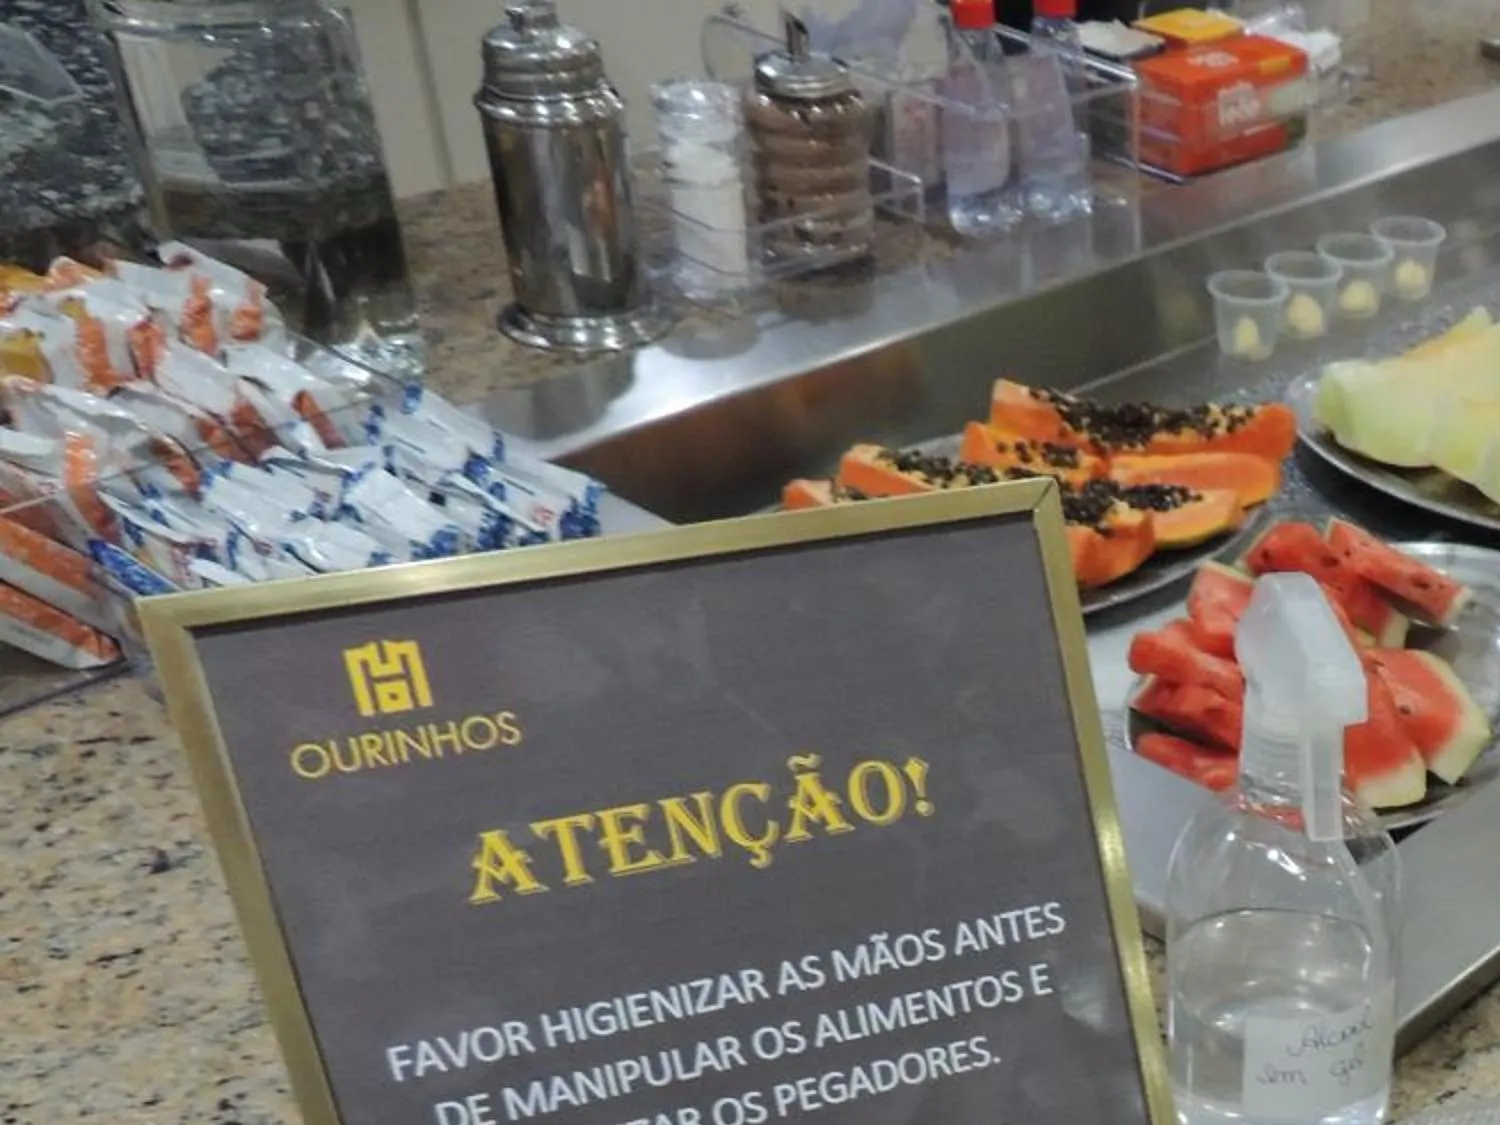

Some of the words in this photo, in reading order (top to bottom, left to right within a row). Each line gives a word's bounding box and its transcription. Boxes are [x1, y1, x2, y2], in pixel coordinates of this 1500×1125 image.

[290, 711, 522, 778] OURINHOS
[468, 753, 935, 903] ATENÇÃO!
[384, 1020, 537, 1083] FAVOR
[540, 967, 769, 1049] HIGIENIZAR
[776, 954, 826, 997] AS
[830, 930, 946, 981] MÃOS
[952, 901, 1066, 956] ANTES
[502, 1036, 748, 1122] MANIPULAR
[750, 1020, 805, 1061] OS
[812, 969, 1026, 1048] ALIMENTOS
[1030, 963, 1054, 997] E
[773, 1034, 1002, 1117] PEGADORES.
